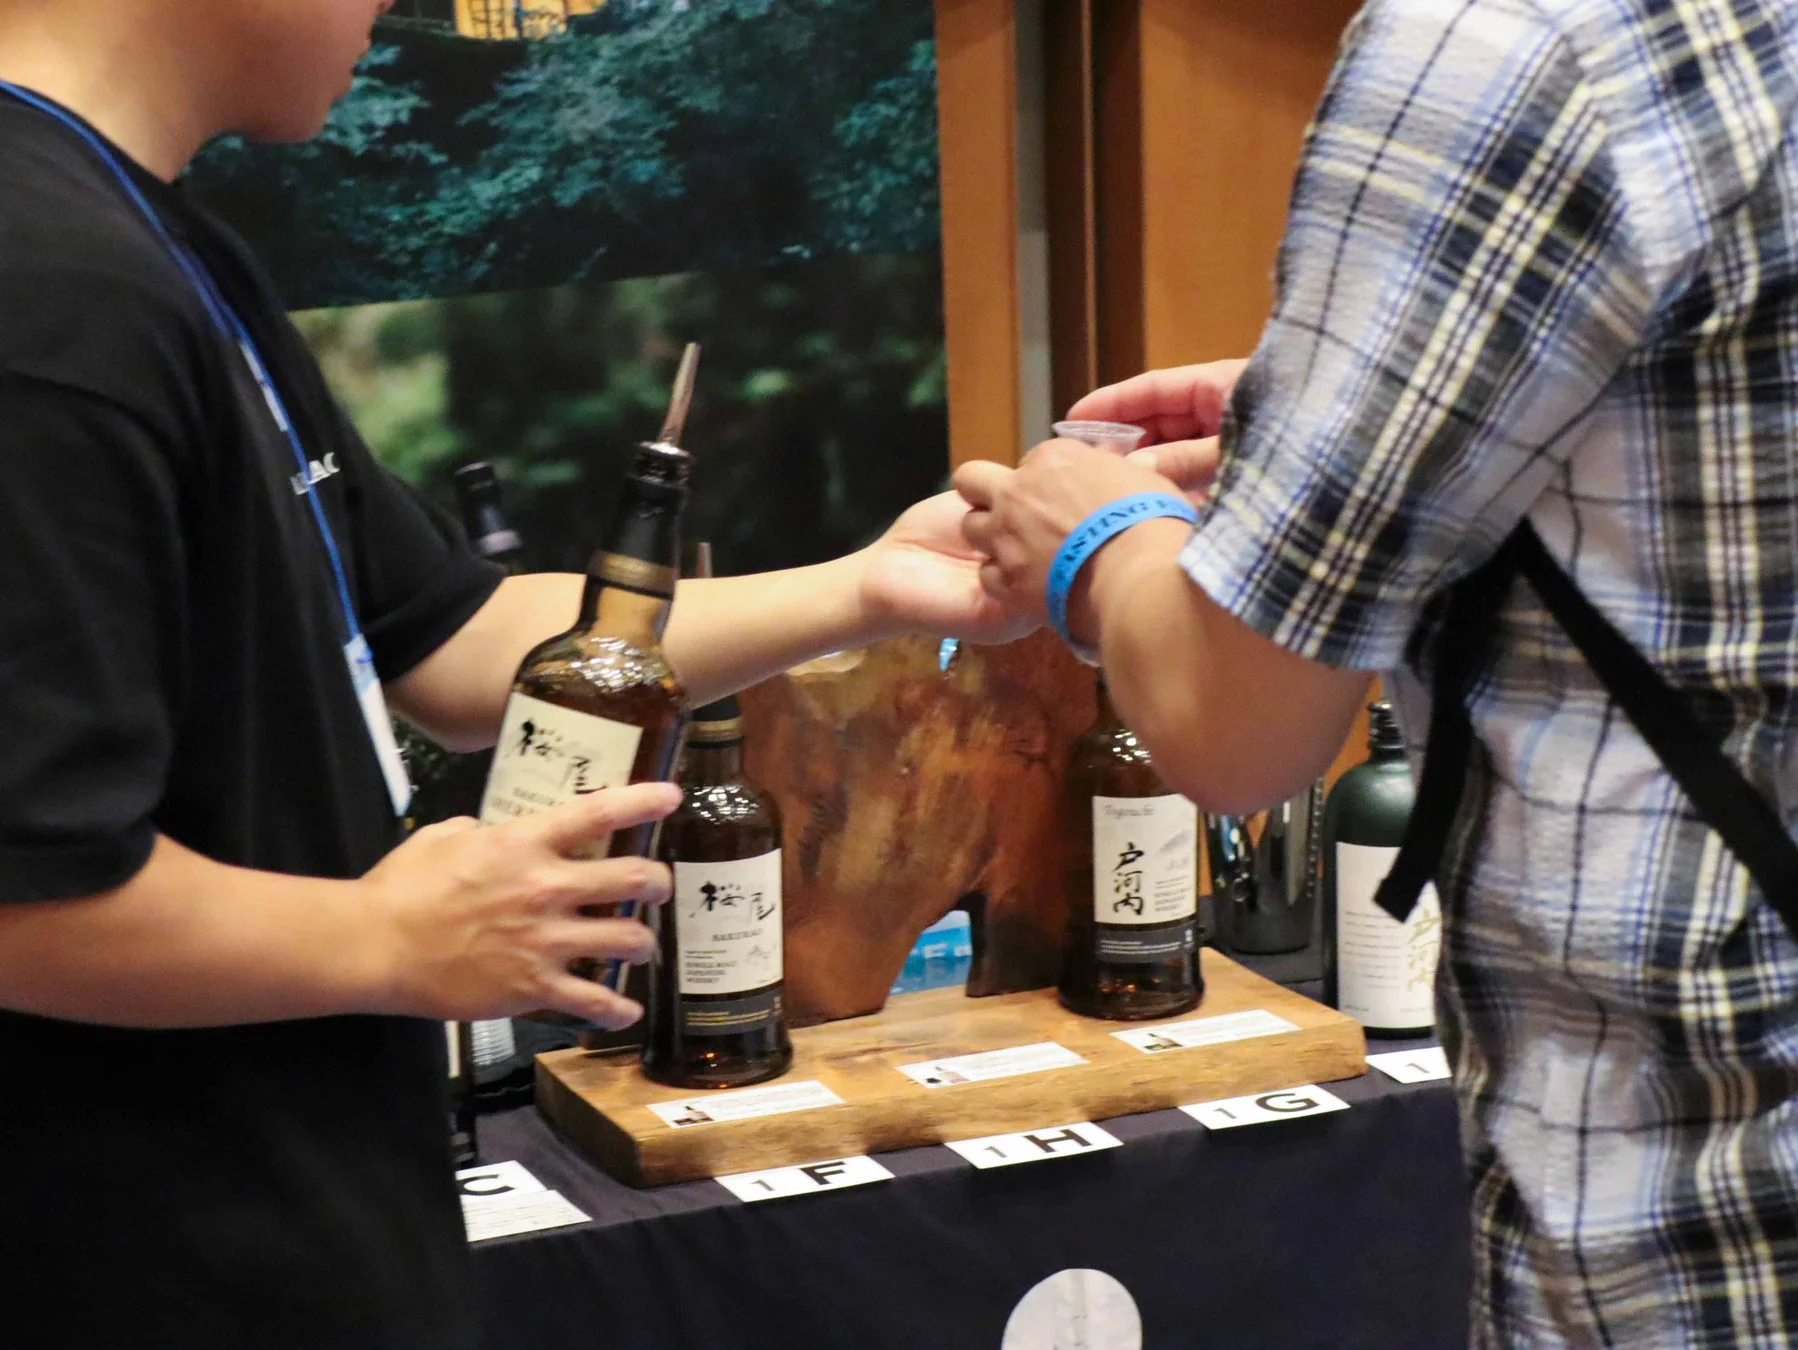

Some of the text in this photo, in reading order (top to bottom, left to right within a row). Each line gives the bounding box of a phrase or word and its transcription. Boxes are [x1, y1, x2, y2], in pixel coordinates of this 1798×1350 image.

[1404, 1062, 1430, 1074] 1
[1211, 1093, 1320, 1120] 1 G
[984, 1129, 1093, 1158] 1 H
[750, 1161, 847, 1192] 1 F
